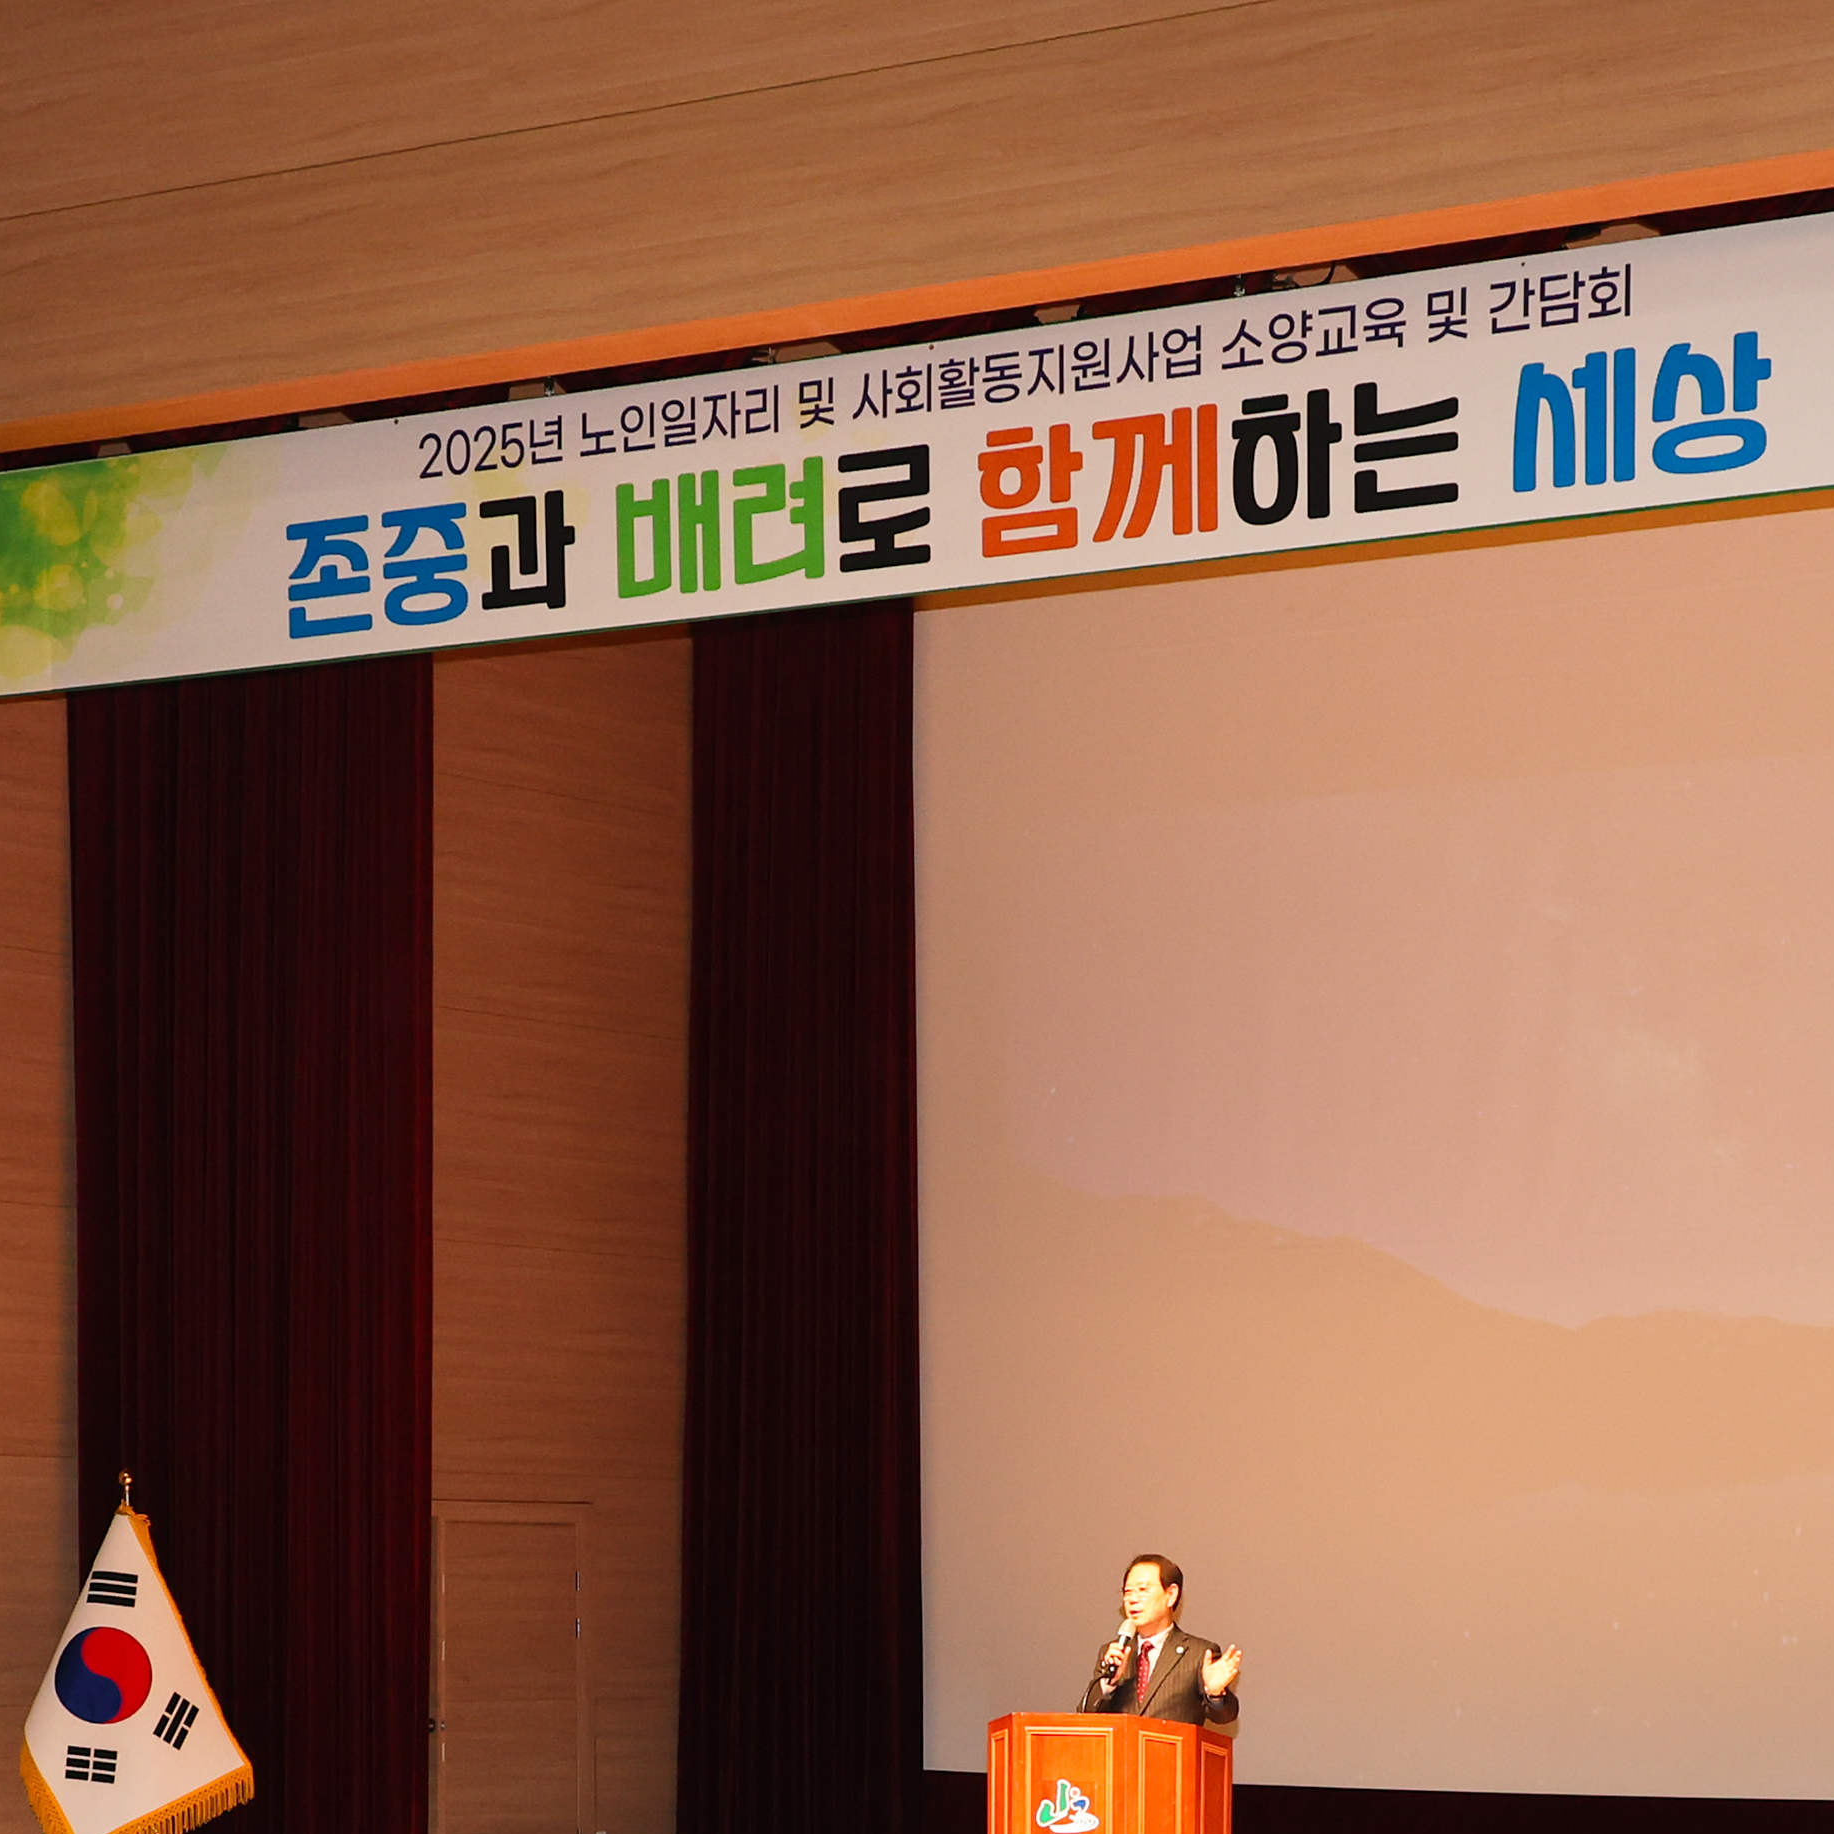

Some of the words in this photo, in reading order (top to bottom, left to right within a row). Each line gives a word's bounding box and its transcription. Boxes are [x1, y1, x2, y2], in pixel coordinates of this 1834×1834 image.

[285, 489, 576, 640] 존중과
[615, 443, 932, 599] 배려로
[977, 381, 1459, 559] 함께하는
[1512, 331, 1772, 493] 세상
[418, 414, 564, 480] 2025년
[579, 384, 779, 458] 노인일자리
[798, 376, 835, 430] 및
[852, 324, 1202, 420] 사회활동지원사업
[1221, 297, 1407, 370] 소양교육
[1427, 286, 1468, 344] 및
[1489, 263, 1632, 335] 간담회
